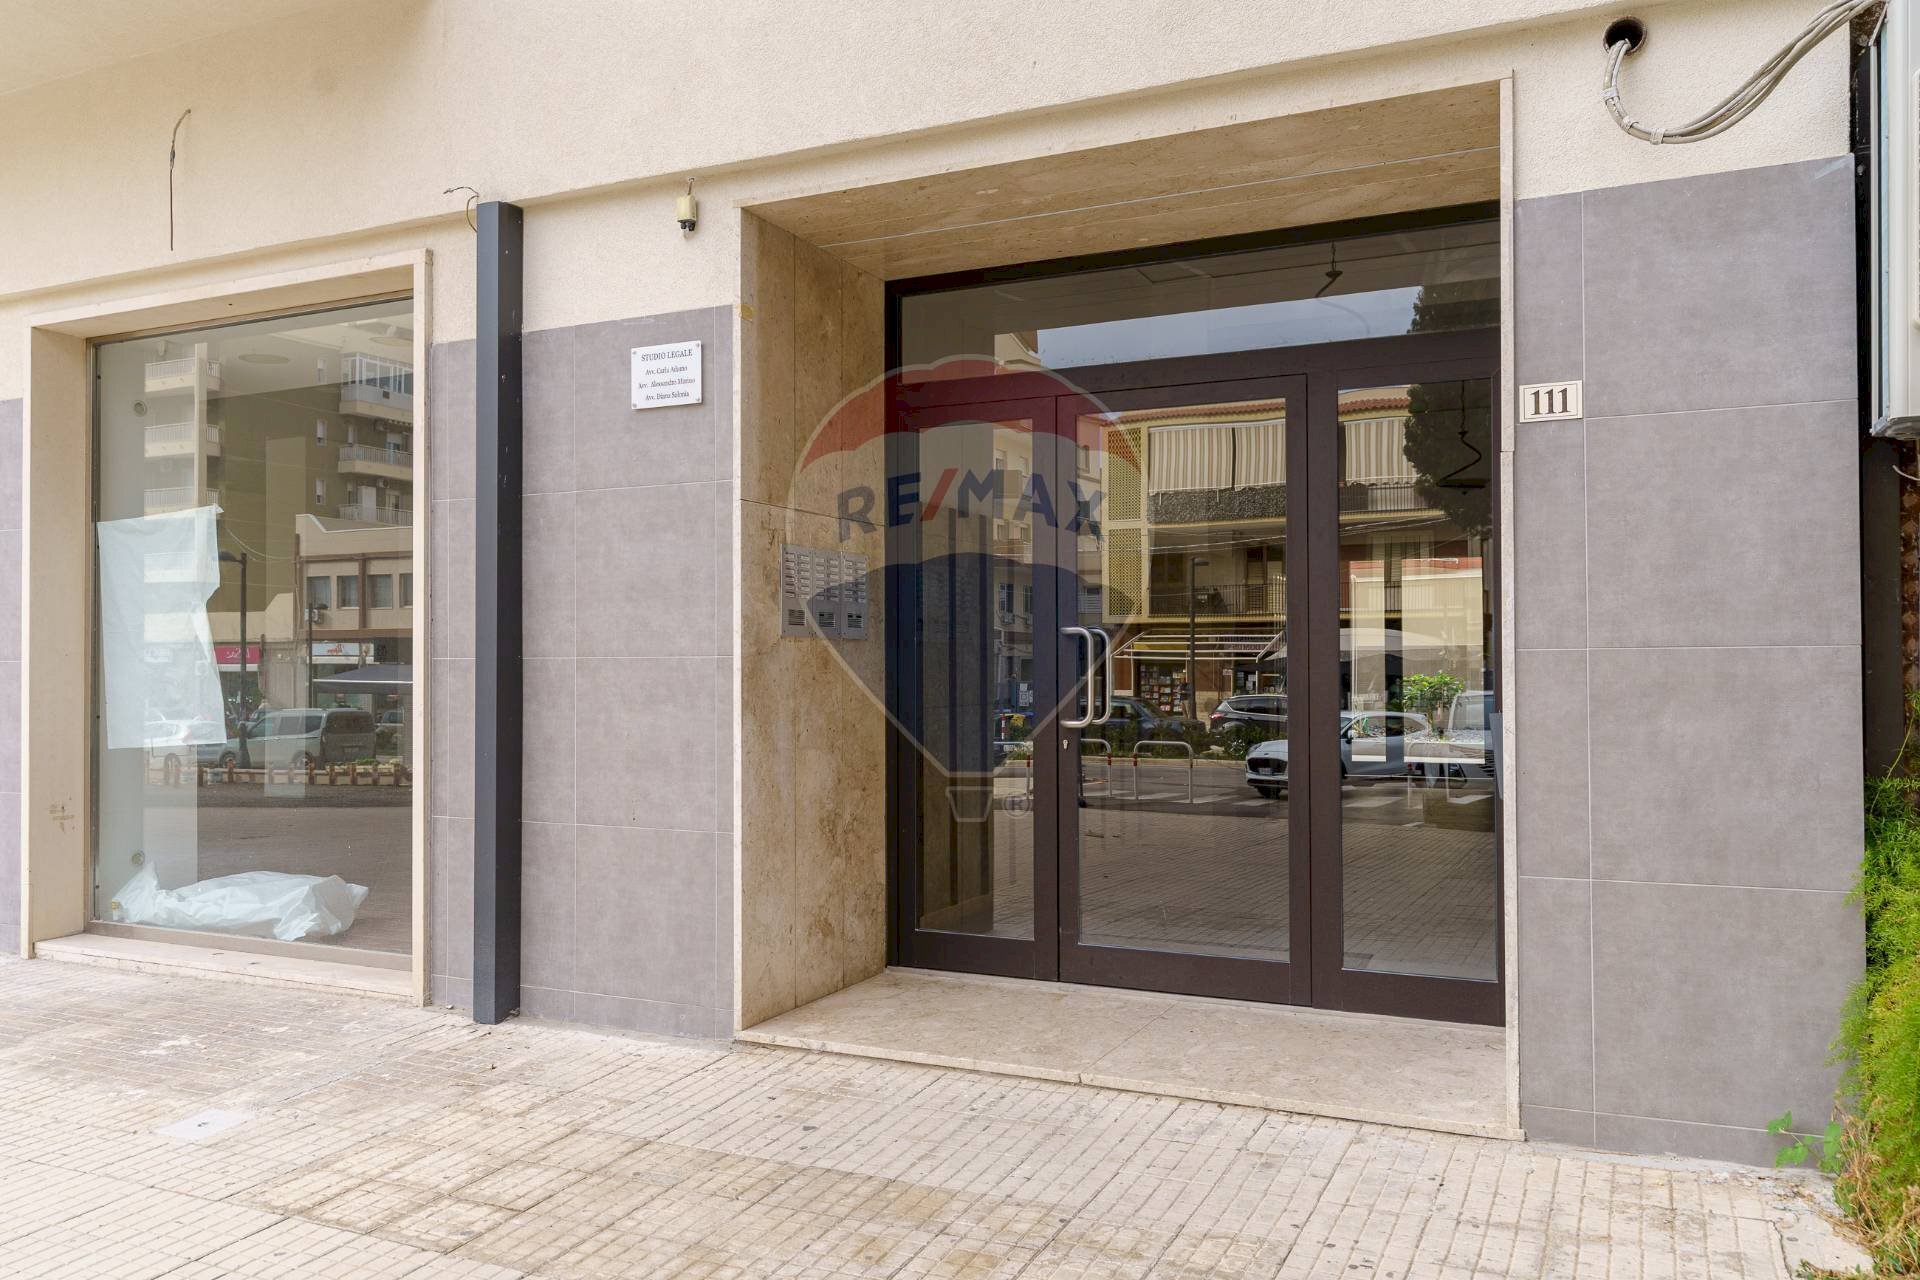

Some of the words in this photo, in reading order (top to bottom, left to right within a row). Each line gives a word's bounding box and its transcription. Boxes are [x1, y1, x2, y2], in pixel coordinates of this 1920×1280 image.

[641, 351, 666, 361] STUDIO
[667, 349, 692, 359] LEGALE
[1529, 387, 1572, 416] 111
